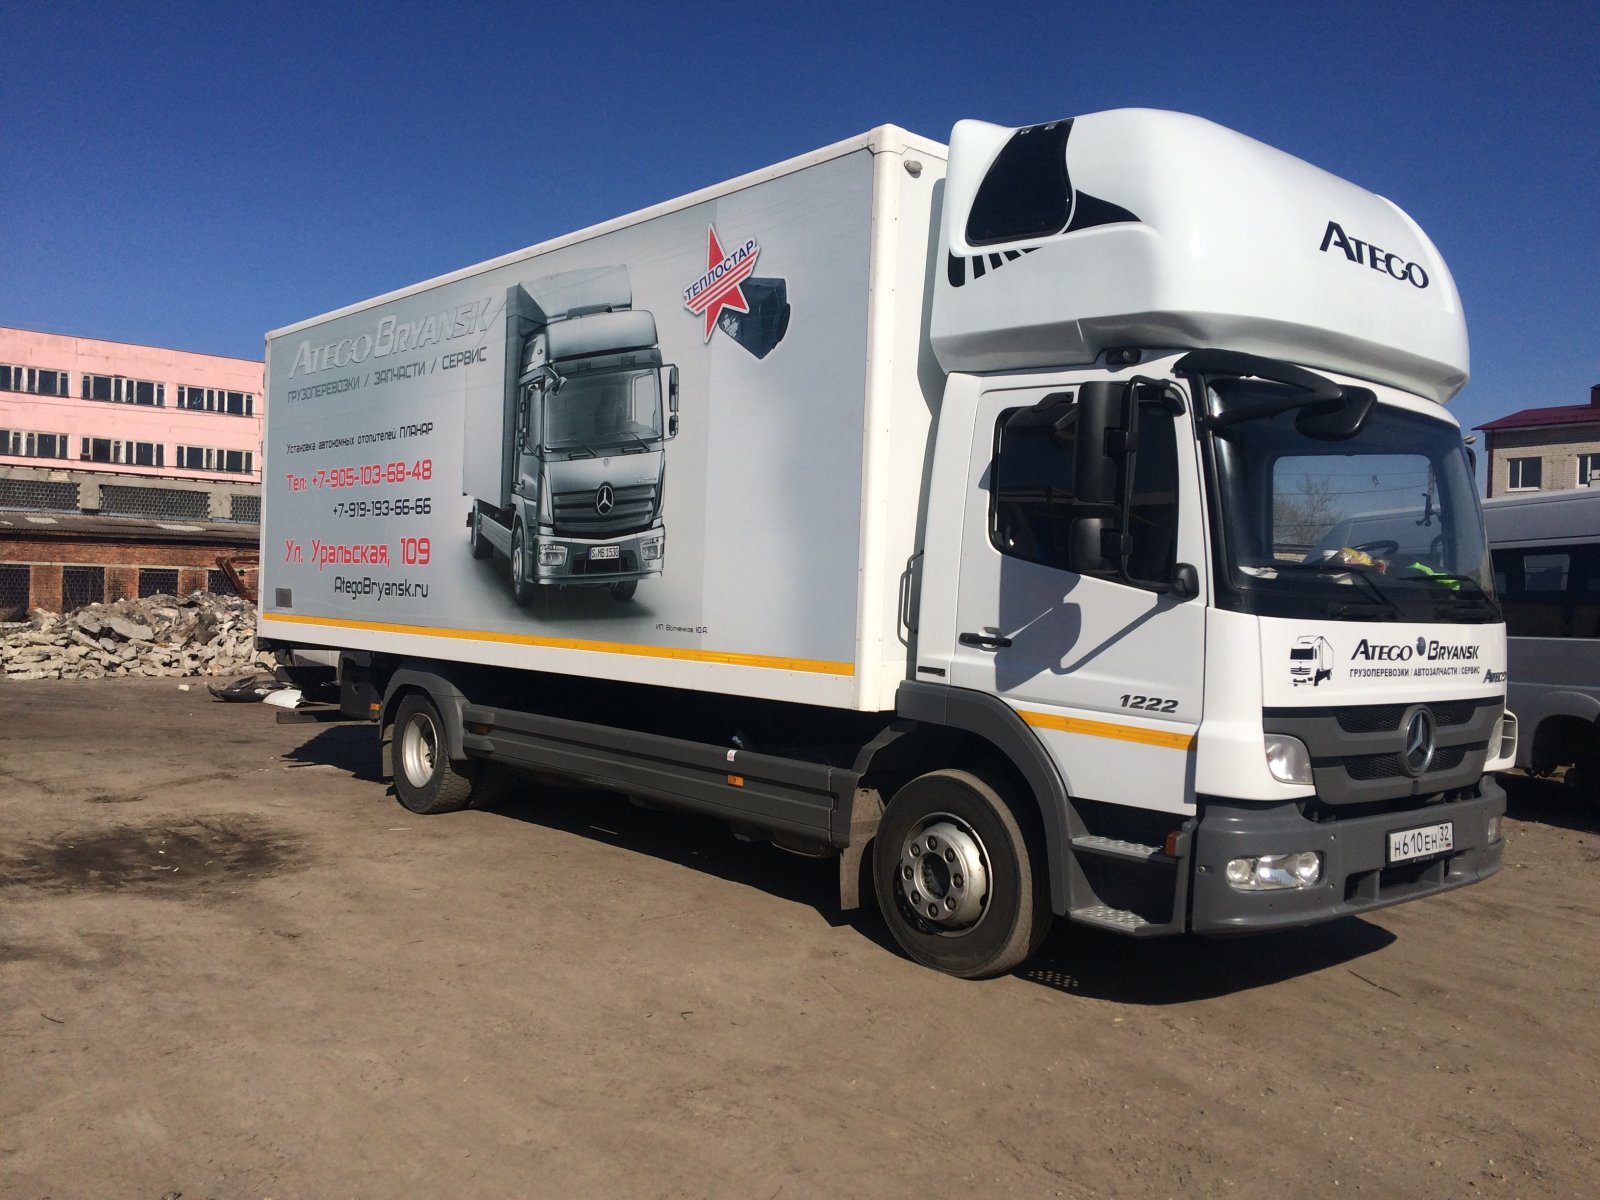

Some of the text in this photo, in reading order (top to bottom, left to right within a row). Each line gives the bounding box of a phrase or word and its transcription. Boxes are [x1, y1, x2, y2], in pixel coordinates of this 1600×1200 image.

[684, 240, 754, 300] ТЕПЛОСТАР
[1319, 220, 1430, 289] ATEGO
[288, 376, 360, 404] ГРУЗОПЕРЕВОЗКИ
[373, 361, 426, 386] ЗАПЧАСТИ
[442, 346, 488, 370] СЕРВИС
[286, 422, 434, 455] Установка автономных отопителей ПЛАНАР
[286, 459, 432, 491] Тел: +7-905-103-68-48
[333, 497, 432, 518] +7-919-193-66-66
[285, 537, 431, 571] Ул. Уральская, 109
[334, 576, 429, 601] AtegoBryansk.ru
[1351, 638, 1480, 661] ATEGO BRYANSK
[1349, 668, 1409, 678] ГРУЗОПЕРЕВОЗКИ
[1414, 667, 1458, 677] АВТОЗАПЧАСТИ
[1461, 666, 1480, 675] СЕРВИС
[1120, 694, 1179, 714] 1222
